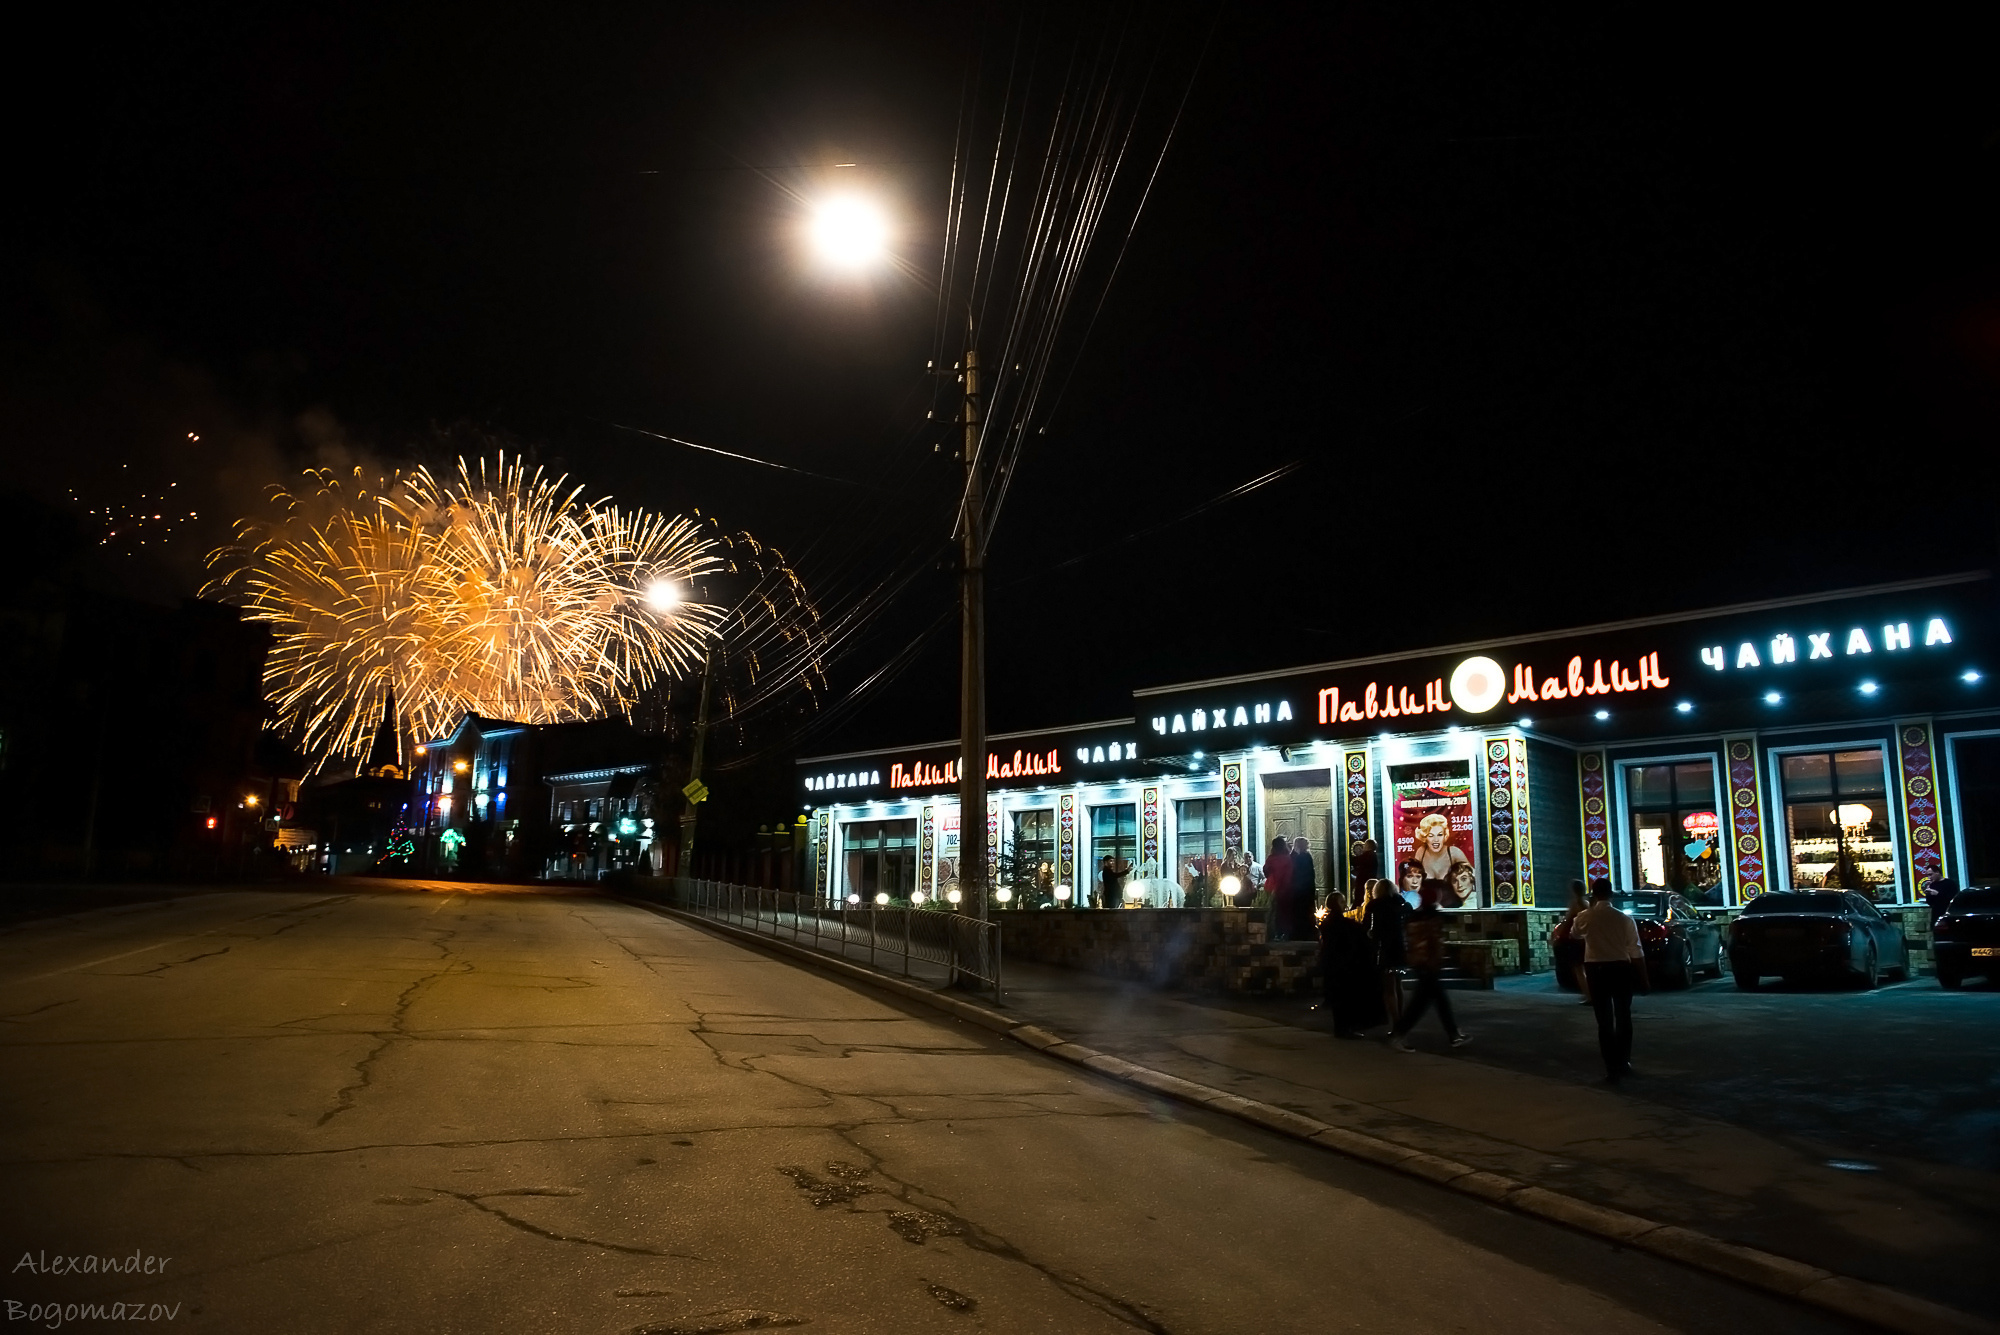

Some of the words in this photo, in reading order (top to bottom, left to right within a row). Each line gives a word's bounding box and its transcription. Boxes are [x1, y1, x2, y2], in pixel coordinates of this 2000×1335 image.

[1701, 618, 1952, 671] ЧАЙХАНА
[1318, 681, 1451, 725] Павлин
[1507, 651, 1670, 704] Мавлин
[1152, 700, 1293, 735] ЧАЙХАНА
[1076, 742, 1136, 765] ЧАЙХ
[891, 759, 957, 789] Павлин
[986, 749, 1062, 780] Мавлин
[805, 770, 880, 792] ЧАЙХАНА
[1396, 780, 1428, 790] ТОЛЬКО
[1451, 815, 1472, 823] 31/12
[1452, 823, 1473, 831] 22:00
